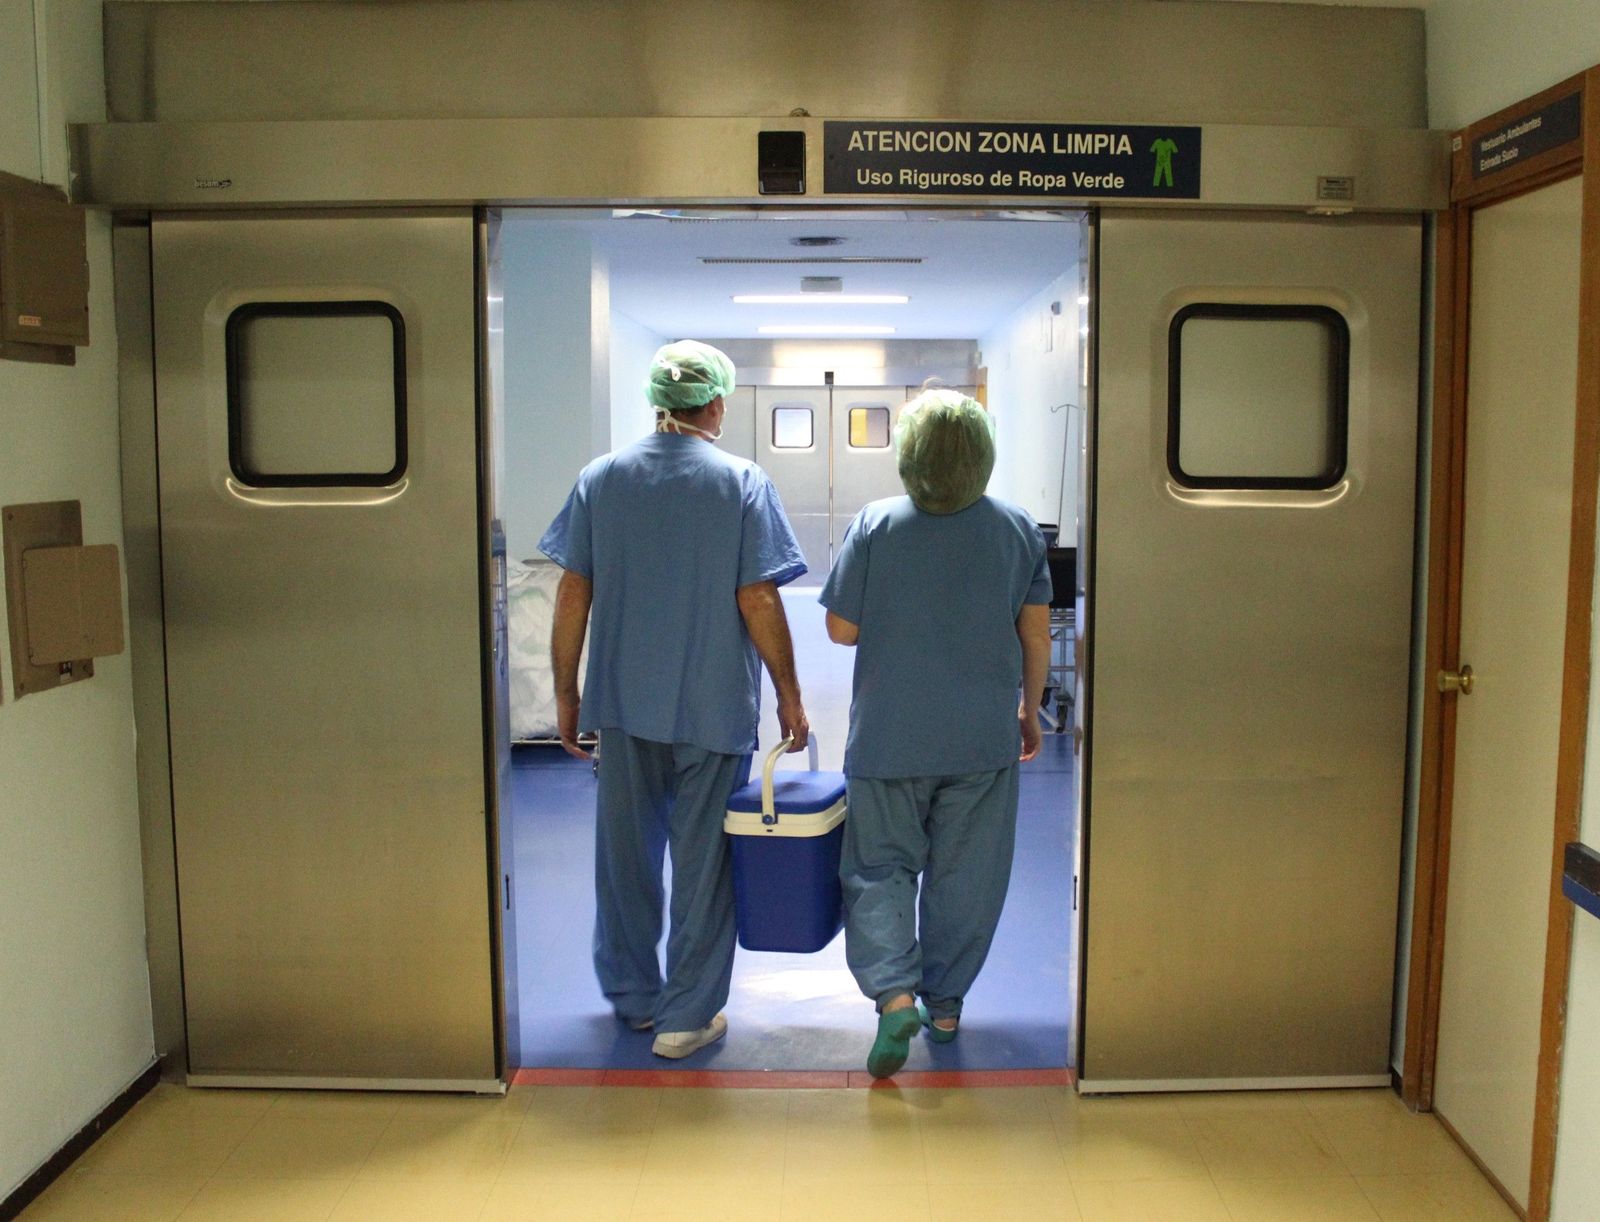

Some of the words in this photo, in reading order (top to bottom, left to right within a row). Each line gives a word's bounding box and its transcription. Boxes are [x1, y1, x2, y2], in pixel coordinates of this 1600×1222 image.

[847, 130, 971, 153] ATENCION
[978, 132, 1046, 154] ZONA
[1053, 133, 1133, 155] LIMPIA
[857, 168, 893, 185] Uso
[899, 169, 984, 189] Riguroso
[990, 170, 1012, 187] de
[1018, 171, 1067, 191] Ropa
[1072, 172, 1125, 189] Verde
